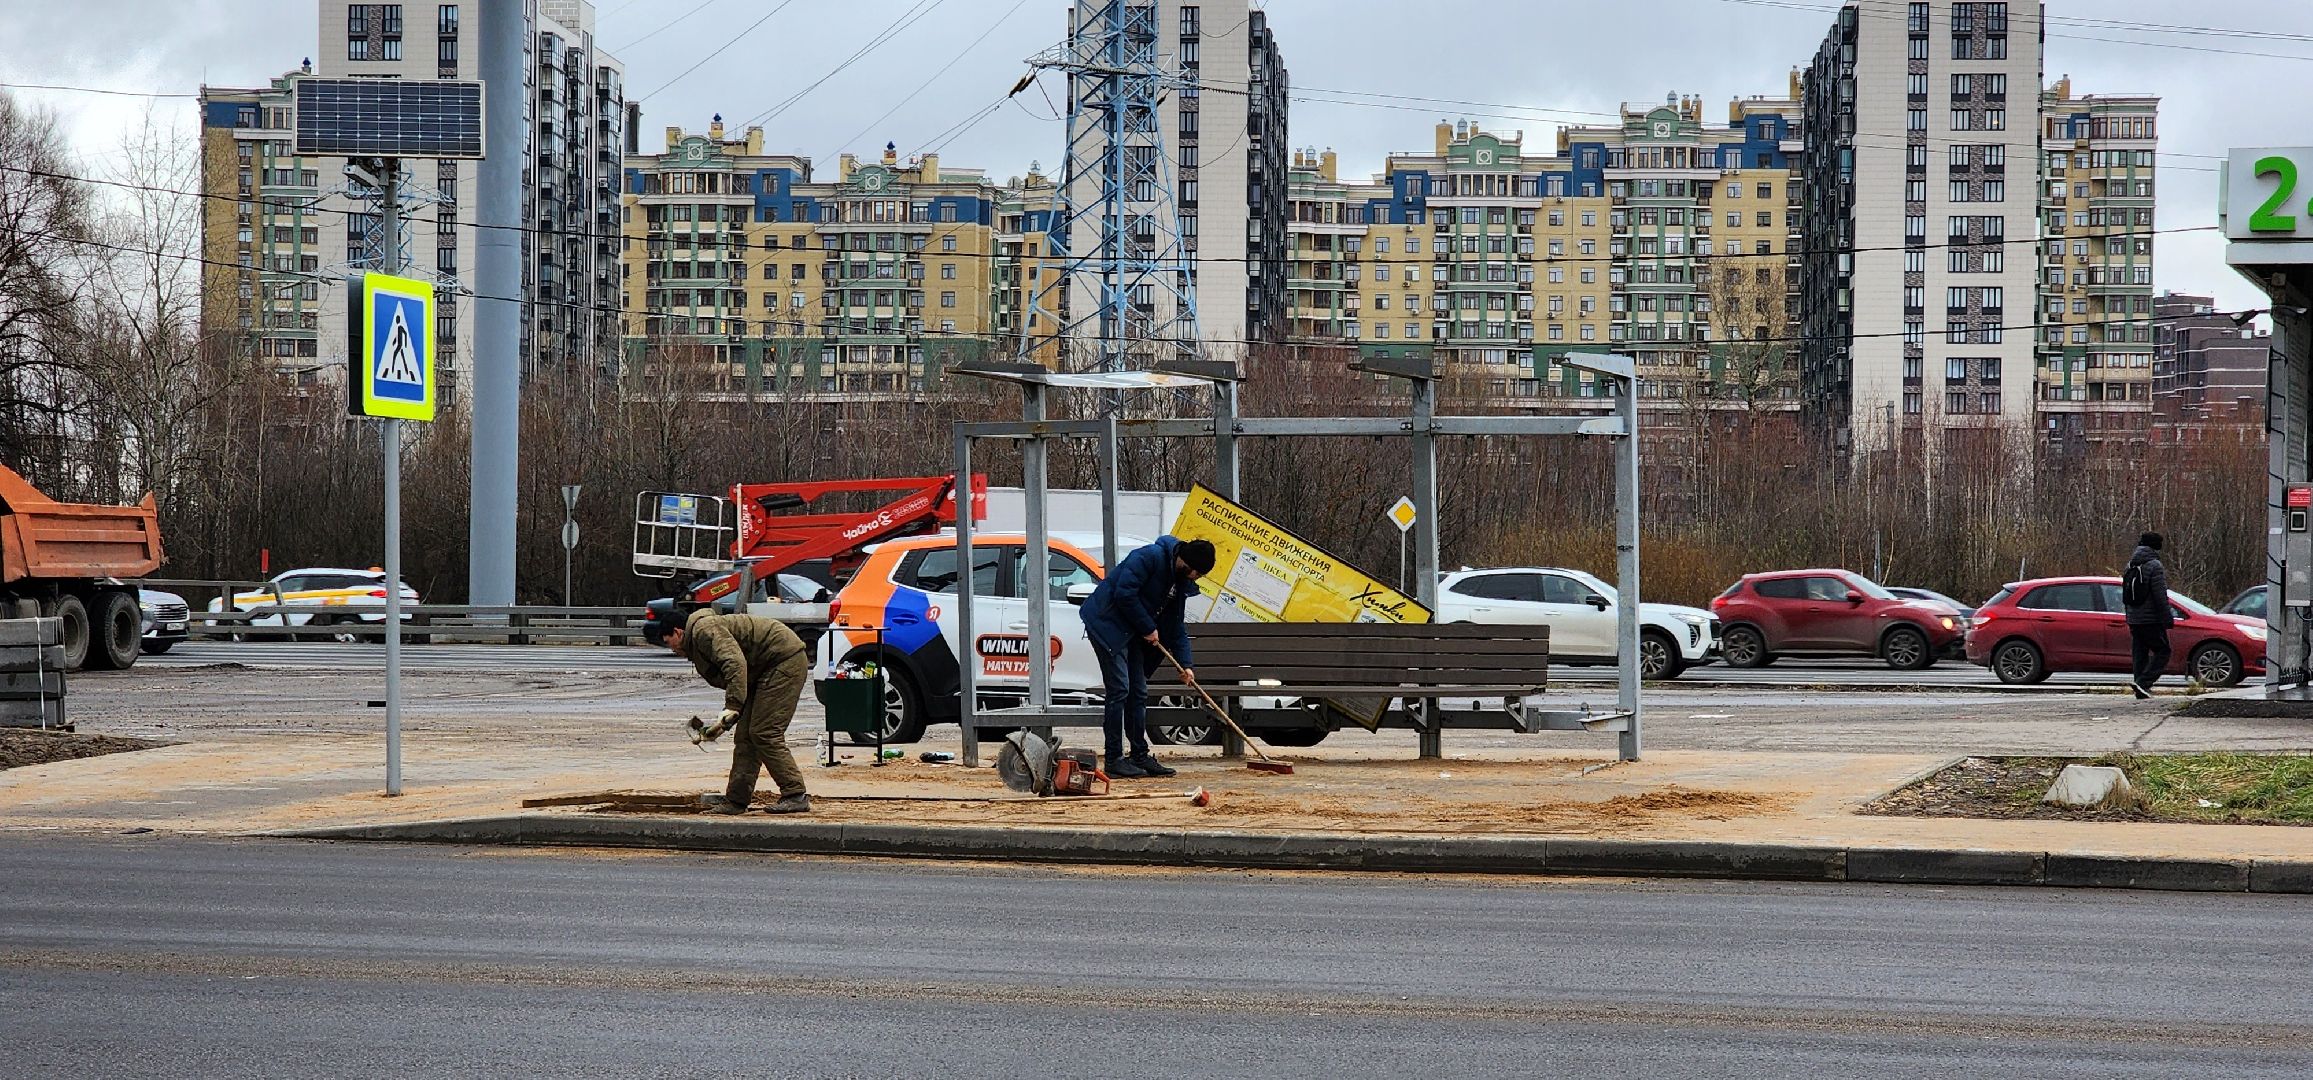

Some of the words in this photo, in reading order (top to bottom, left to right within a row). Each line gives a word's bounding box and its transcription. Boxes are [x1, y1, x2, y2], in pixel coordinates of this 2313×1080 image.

[2249, 156, 2313, 232] 2
[1196, 508, 1271, 552] ОБЩЕСТВЕННОГО
[1272, 548, 1325, 582] ТРАНСПОРТА
[1202, 497, 1270, 539] РАСПИСАНИЕ
[1269, 534, 1332, 573] ДВИЖЕНИЯ
[982, 639, 1029, 654] WINLIN
[986, 660, 1012, 672] МАТЧ
